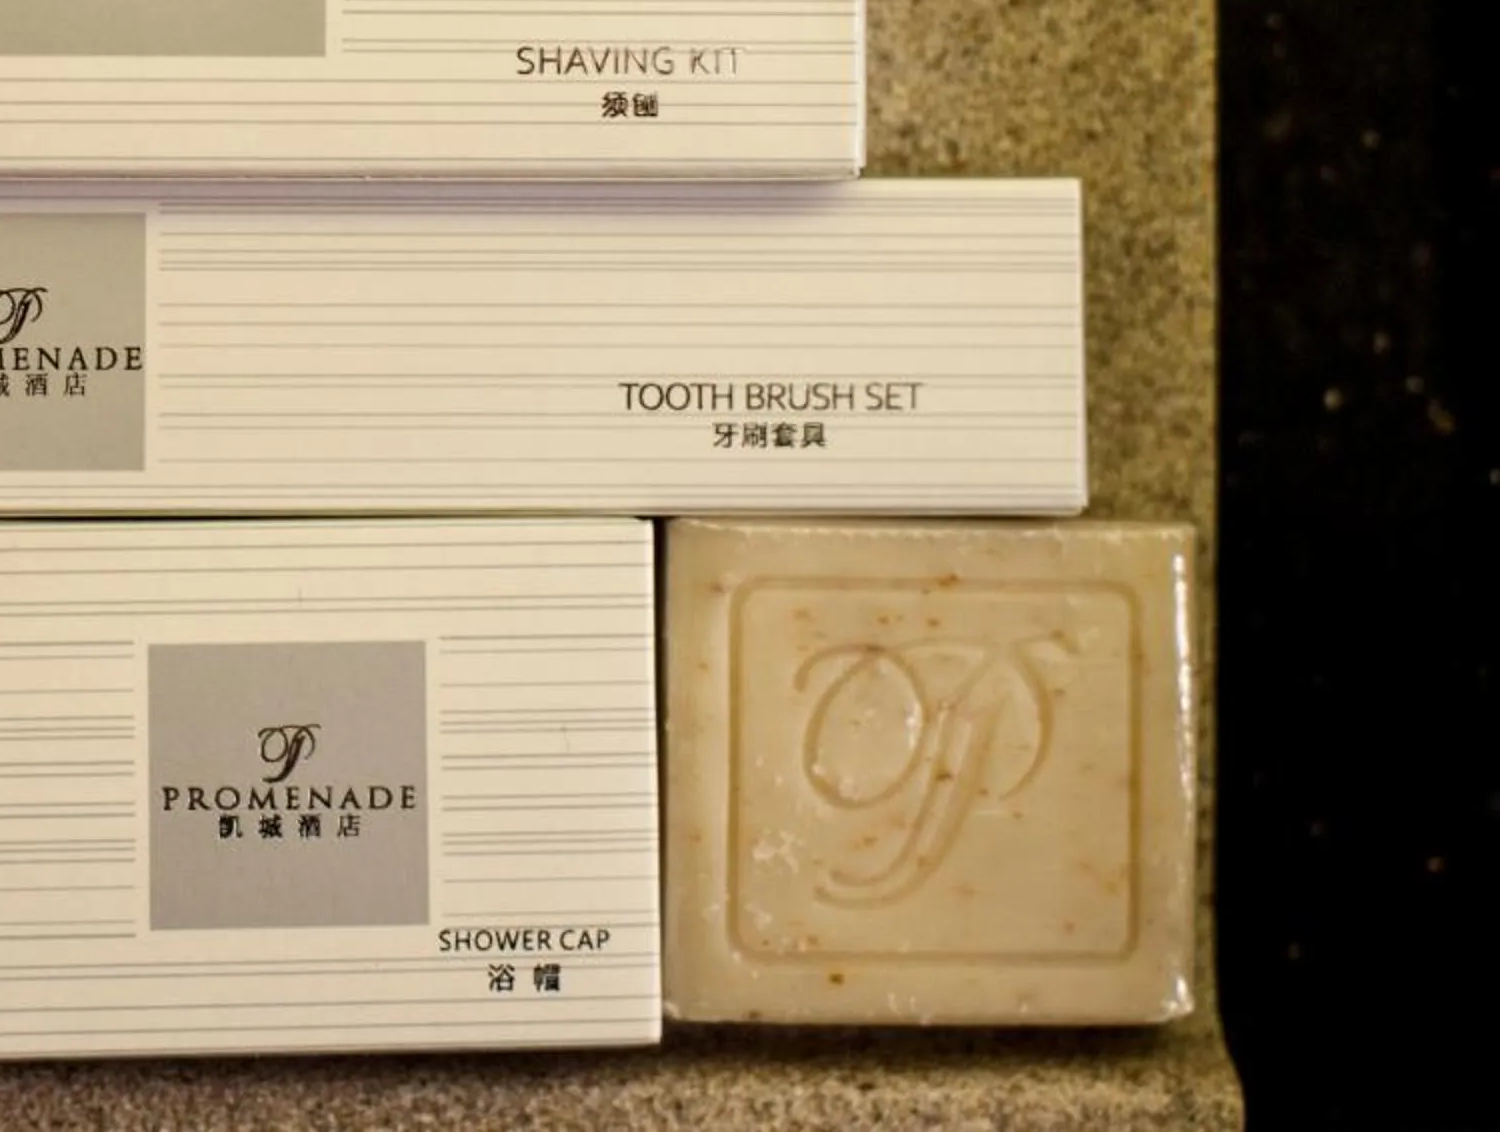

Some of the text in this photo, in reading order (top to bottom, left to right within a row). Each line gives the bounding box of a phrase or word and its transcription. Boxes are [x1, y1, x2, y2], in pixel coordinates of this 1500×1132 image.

[516, 45, 741, 76] SHAVING KIT
[618, 381, 925, 412] TOOTH BRUSH SET
[162, 785, 417, 811] PROMENADE
[218, 814, 361, 839] 凯城酒店
[438, 928, 611, 952] SHOWER CAP
